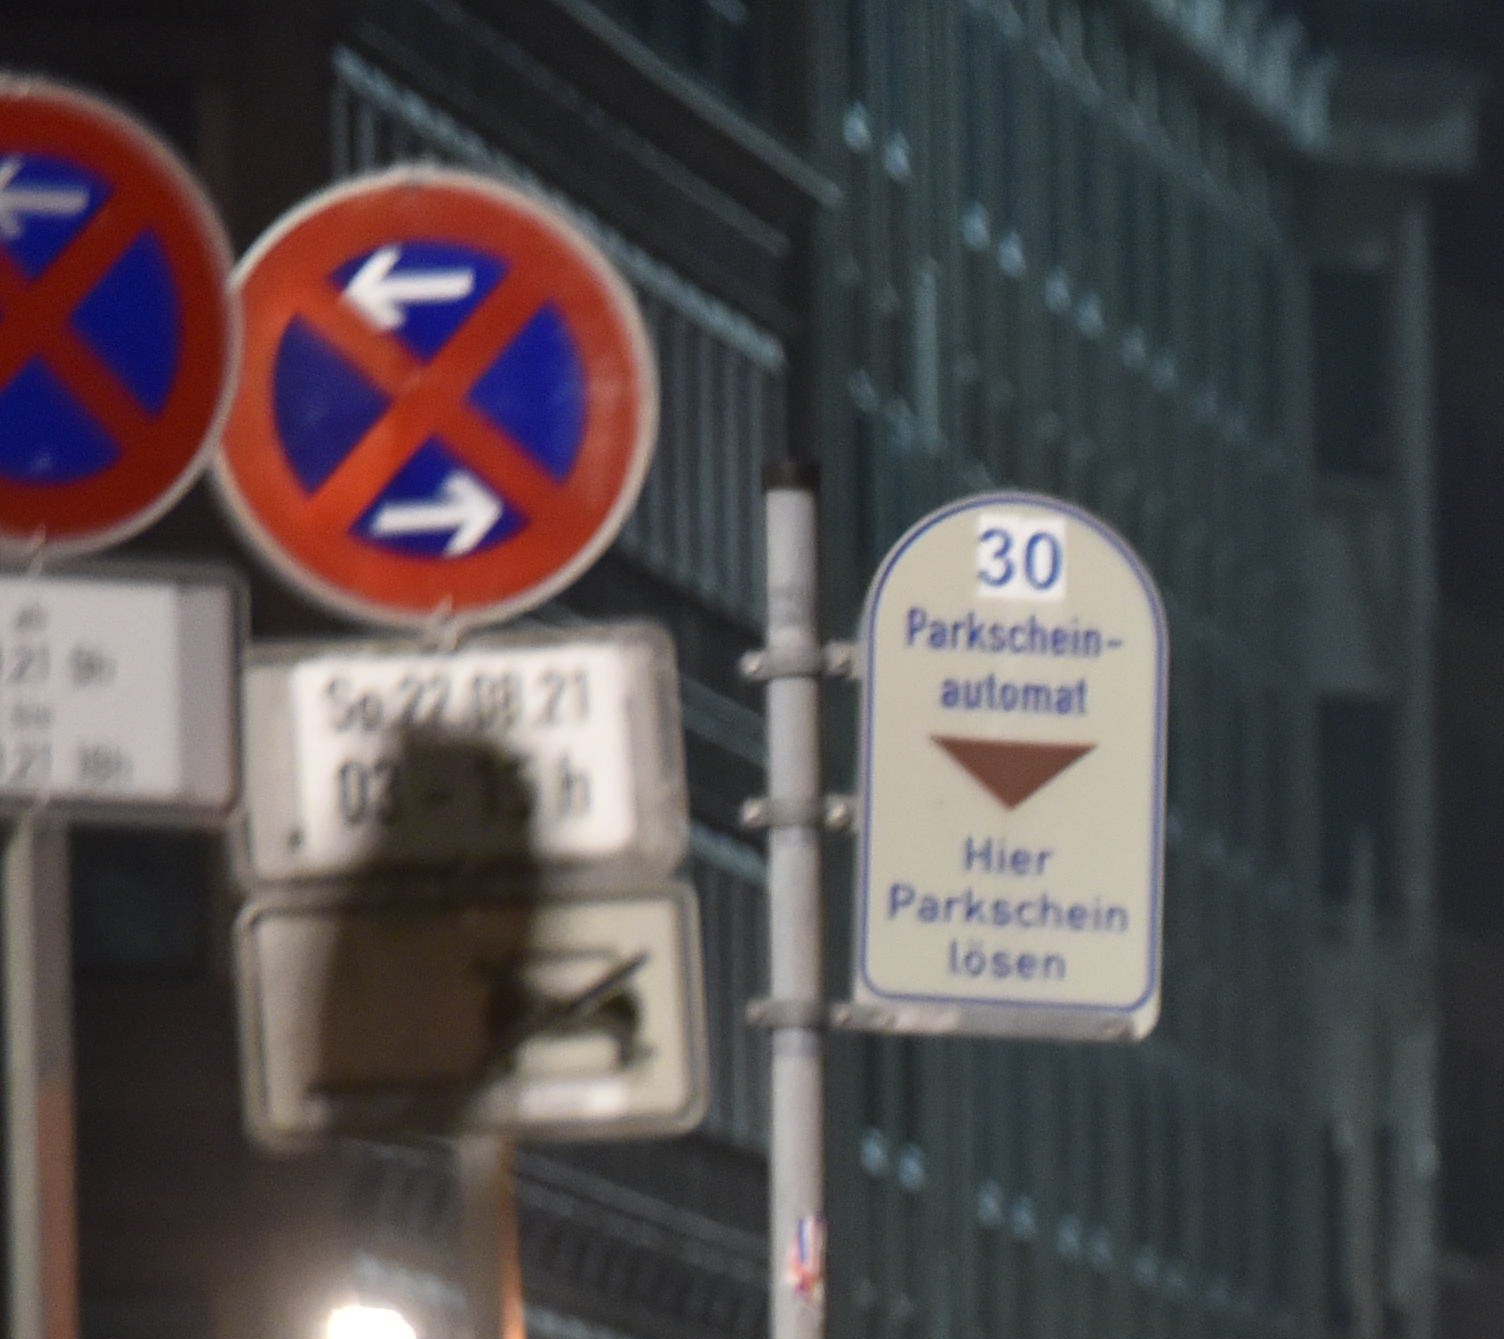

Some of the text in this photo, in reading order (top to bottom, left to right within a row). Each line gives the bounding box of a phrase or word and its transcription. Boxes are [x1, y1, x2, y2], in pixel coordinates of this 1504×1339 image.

[977, 528, 1062, 590] 30
[906, 606, 1123, 657] Parkschein-
[939, 673, 1087, 715] automat
[962, 836, 1053, 877] Hier
[887, 882, 1129, 932] Parkschein
[948, 937, 1067, 980] lösen
